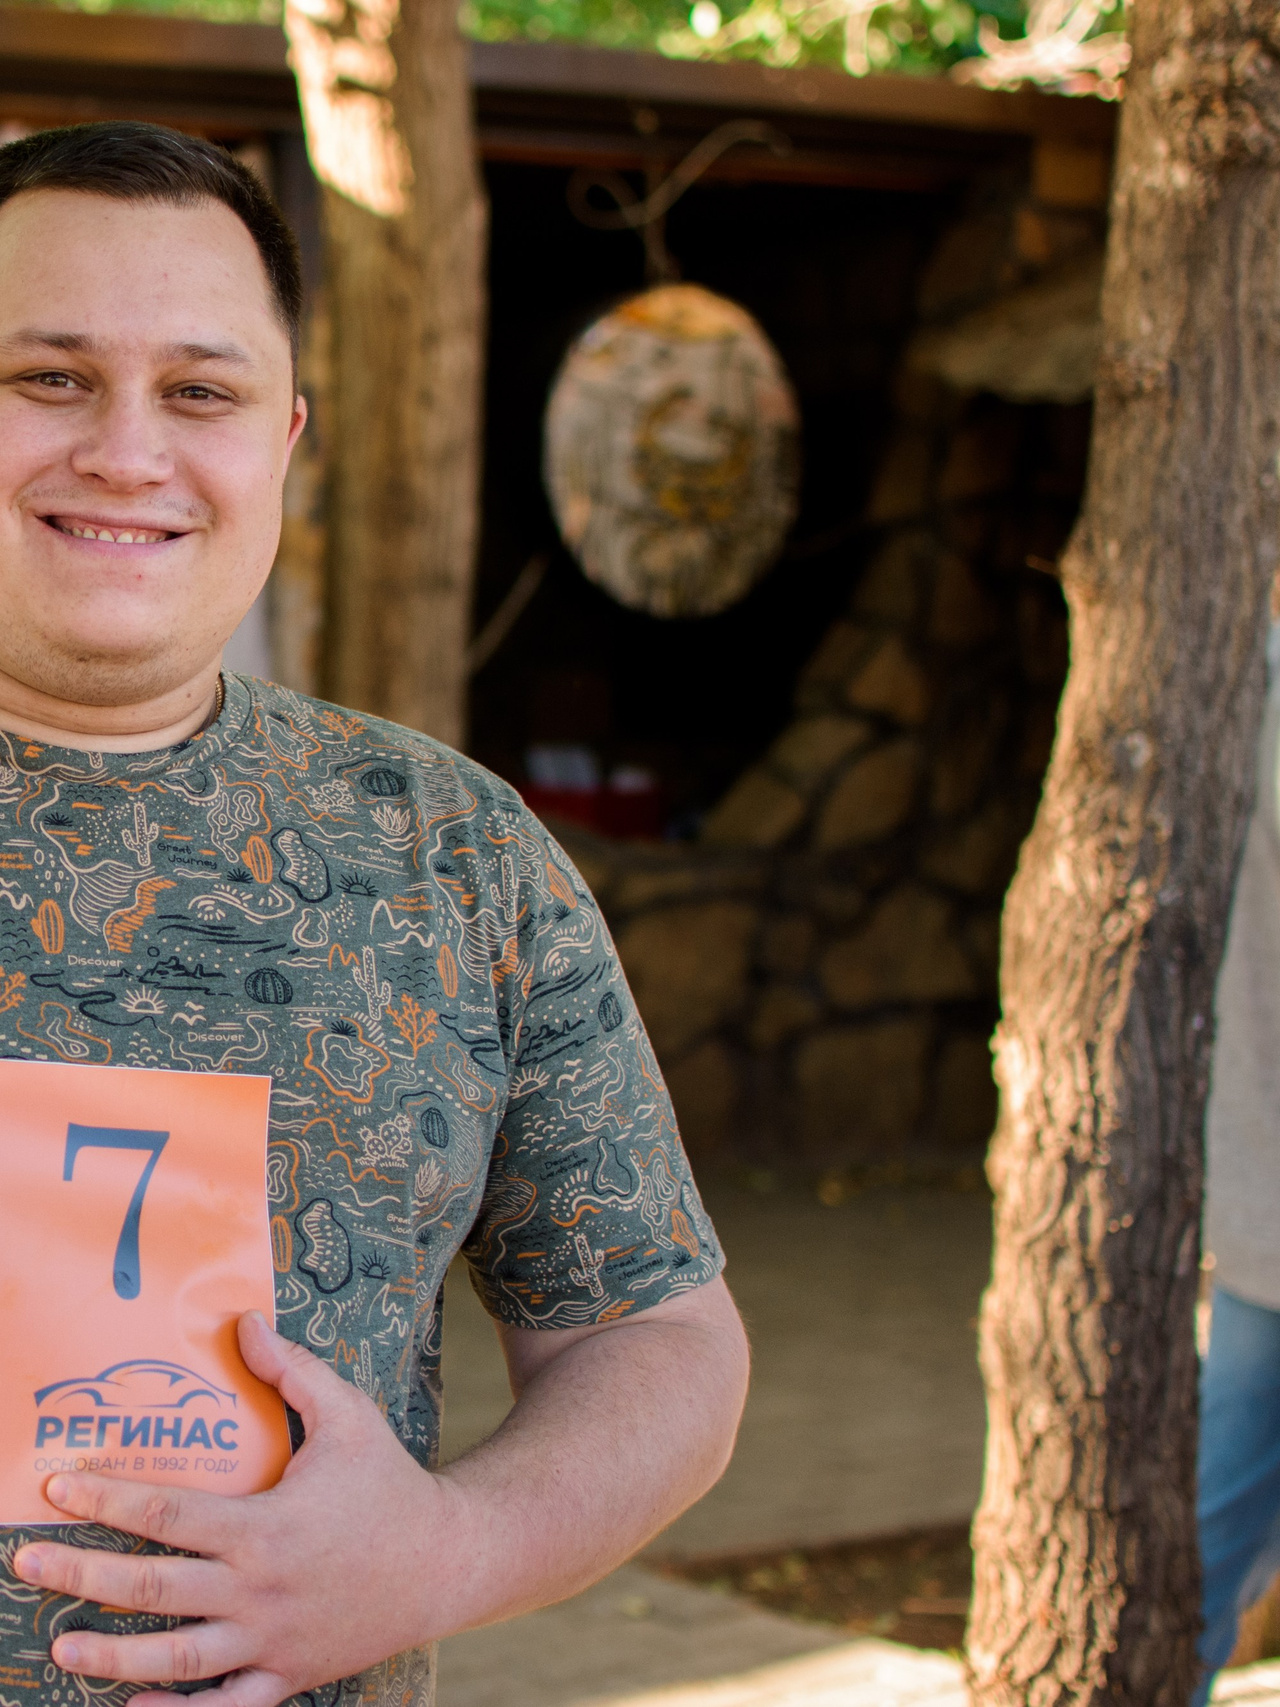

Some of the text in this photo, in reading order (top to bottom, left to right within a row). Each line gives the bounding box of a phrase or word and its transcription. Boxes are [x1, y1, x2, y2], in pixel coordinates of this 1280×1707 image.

[157, 842, 192, 855] Great
[357, 845, 383, 855] Great
[168, 855, 218, 870] Journey
[366, 854, 404, 867] Journey
[67, 954, 123, 968] Discover
[459, 1001, 497, 1015] Discov
[187, 1031, 245, 1043] Discover
[571, 1069, 612, 1097] Discover
[539, 1156, 589, 1181] Landscape
[544, 1150, 579, 1170] Desert
[62, 1121, 170, 1301] 7
[605, 1256, 639, 1275] Great
[618, 1257, 664, 1281] Journey
[34, 1415, 239, 1451] РЕГИНАС
[34, 1456, 239, 1474] ОСНОВАН В 1992 ГОДУ
